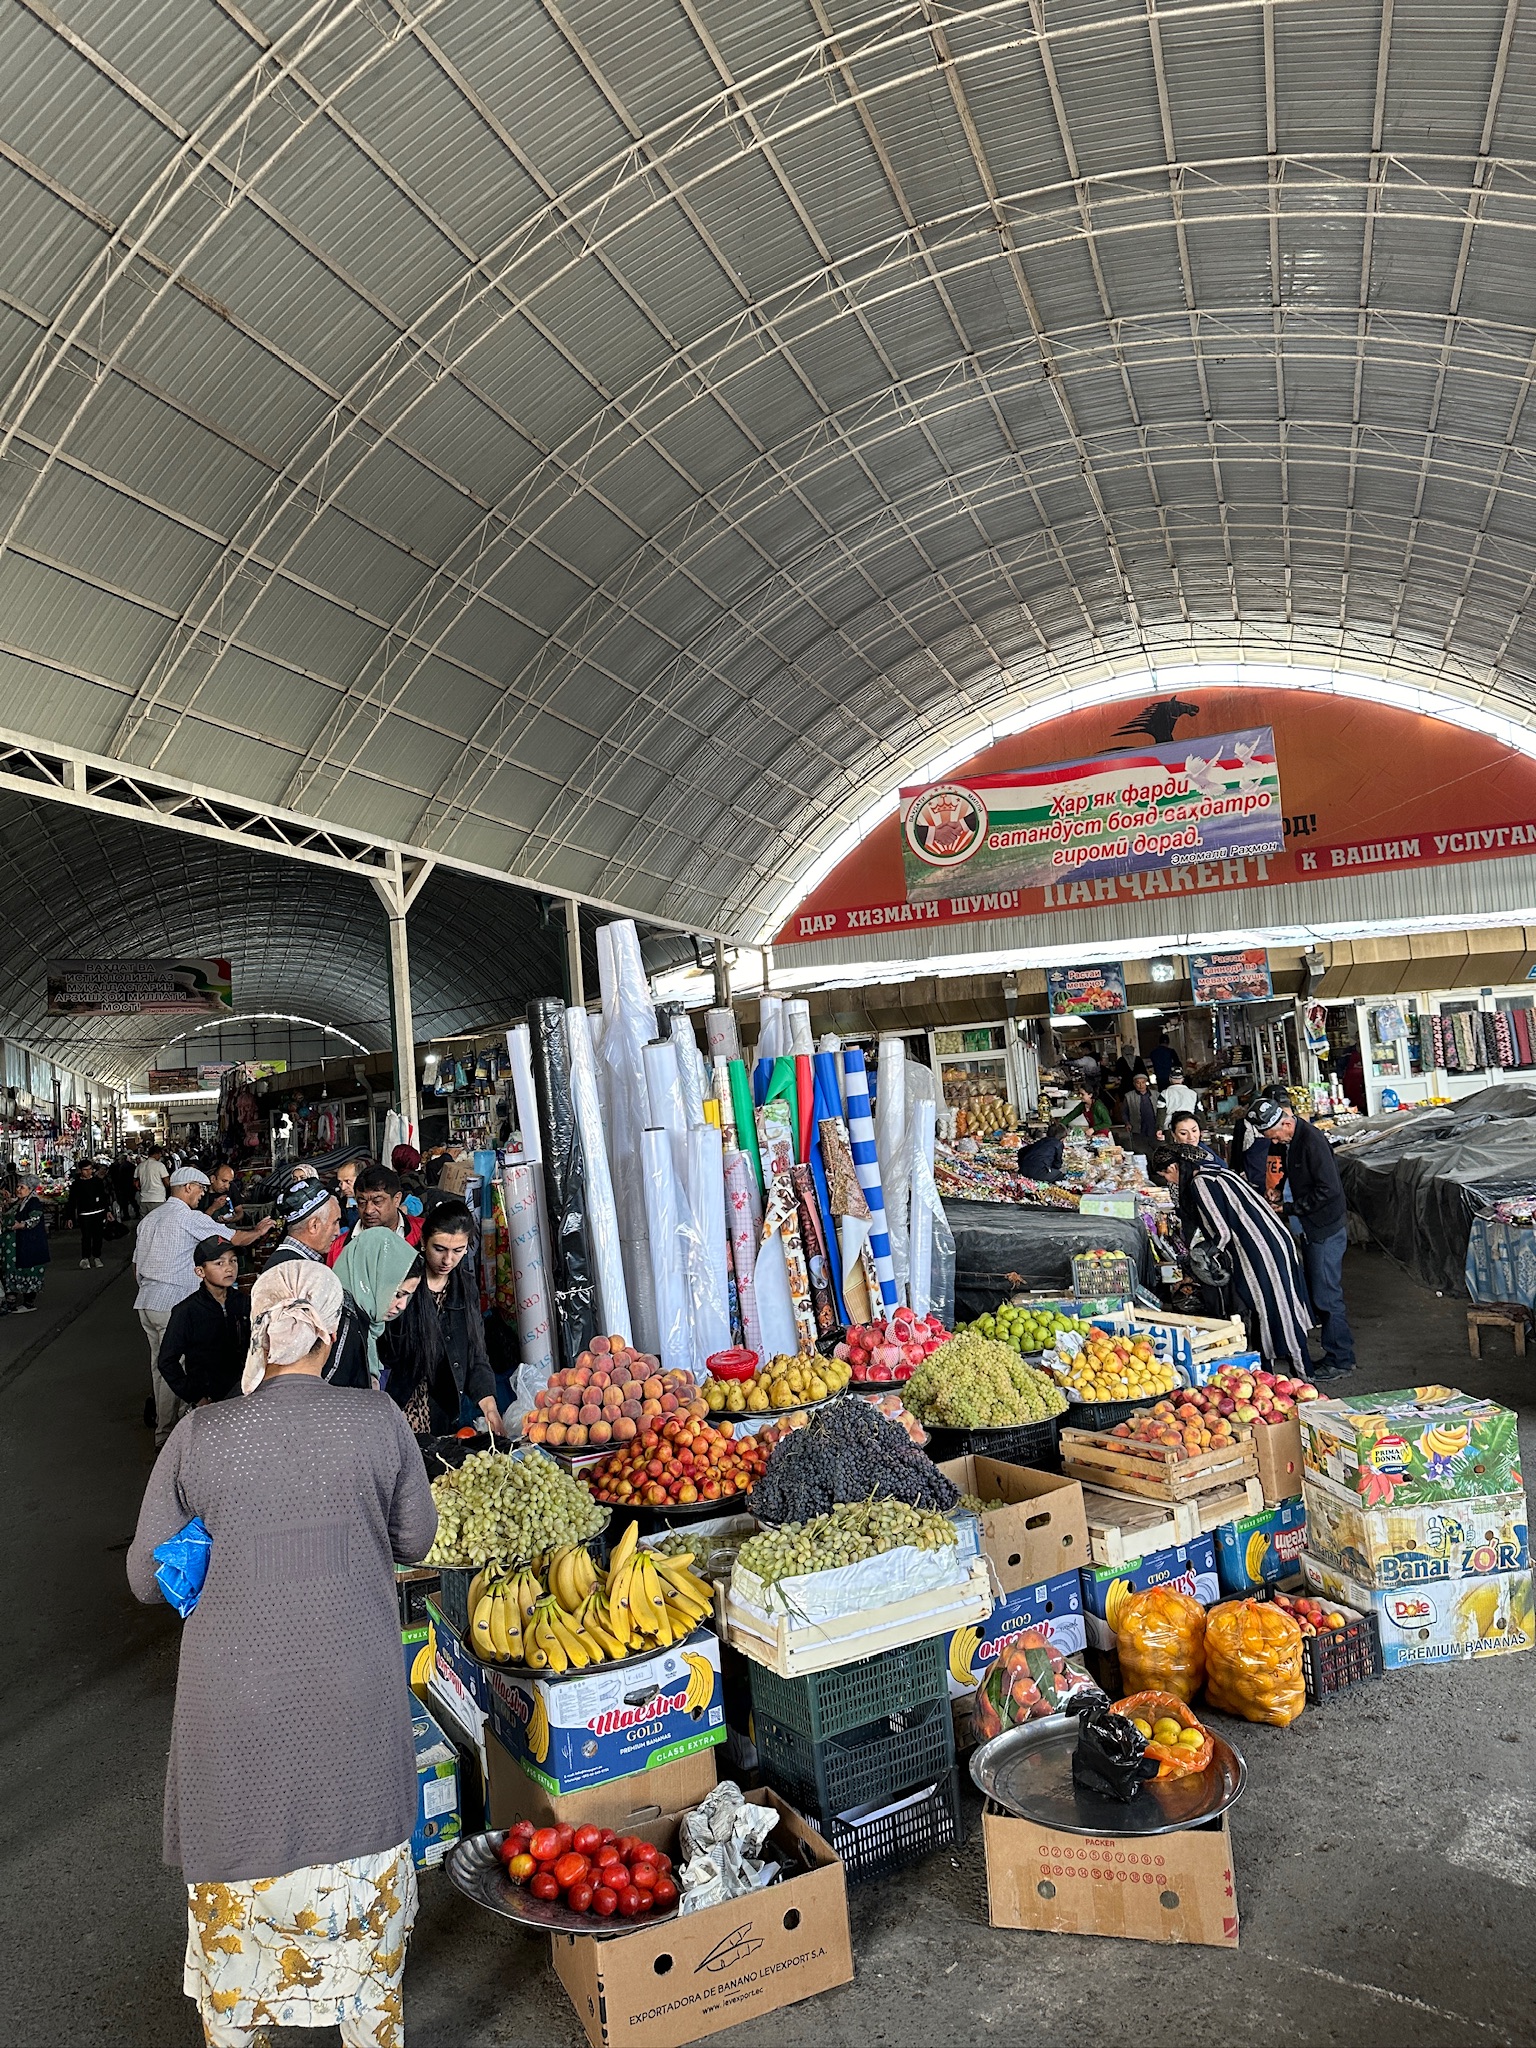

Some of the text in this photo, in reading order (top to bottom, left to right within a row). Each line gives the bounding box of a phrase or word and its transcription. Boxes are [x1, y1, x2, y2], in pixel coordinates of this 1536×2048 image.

[1051, 778, 1189, 817] Ҳар як фарди
[989, 793, 1271, 848] ватандӯст бояд ваҳдатро
[1053, 827, 1203, 864] гиромӣ дорад.
[1301, 852, 1318, 871] К
[1330, 839, 1421, 867] ВАШИМ
[799, 891, 1019, 936] ДАР ХИЗМАТИ ШУМО!
[1211, 954, 1246, 964] Растаи
[1244, 963, 1258, 971] ва
[1068, 969, 1102, 980] Растаи
[101, 1002, 141, 1012] МОСТ!
[1375, 1449, 1400, 1457] PRIMA
[1375, 1455, 1402, 1463] DONNA
[1147, 1569, 1170, 1585] GOLD
[1395, 1601, 1430, 1617] Dole
[1002, 1613, 1032, 1631] GOLD
[1399, 1634, 1526, 1662] PREMIUM BANANAS
[587, 1692, 687, 1735] Maestro
[626, 1722, 663, 1741] GOLD
[619, 1733, 671, 1755] PREMIUM BANANAS
[656, 1735, 715, 1762] CLASS EXTRA
[1085, 1838, 1115, 1847] PACKER
[629, 1947, 828, 2026] EXPORTADORA DE BANANO LEVEXPORT S.A.
